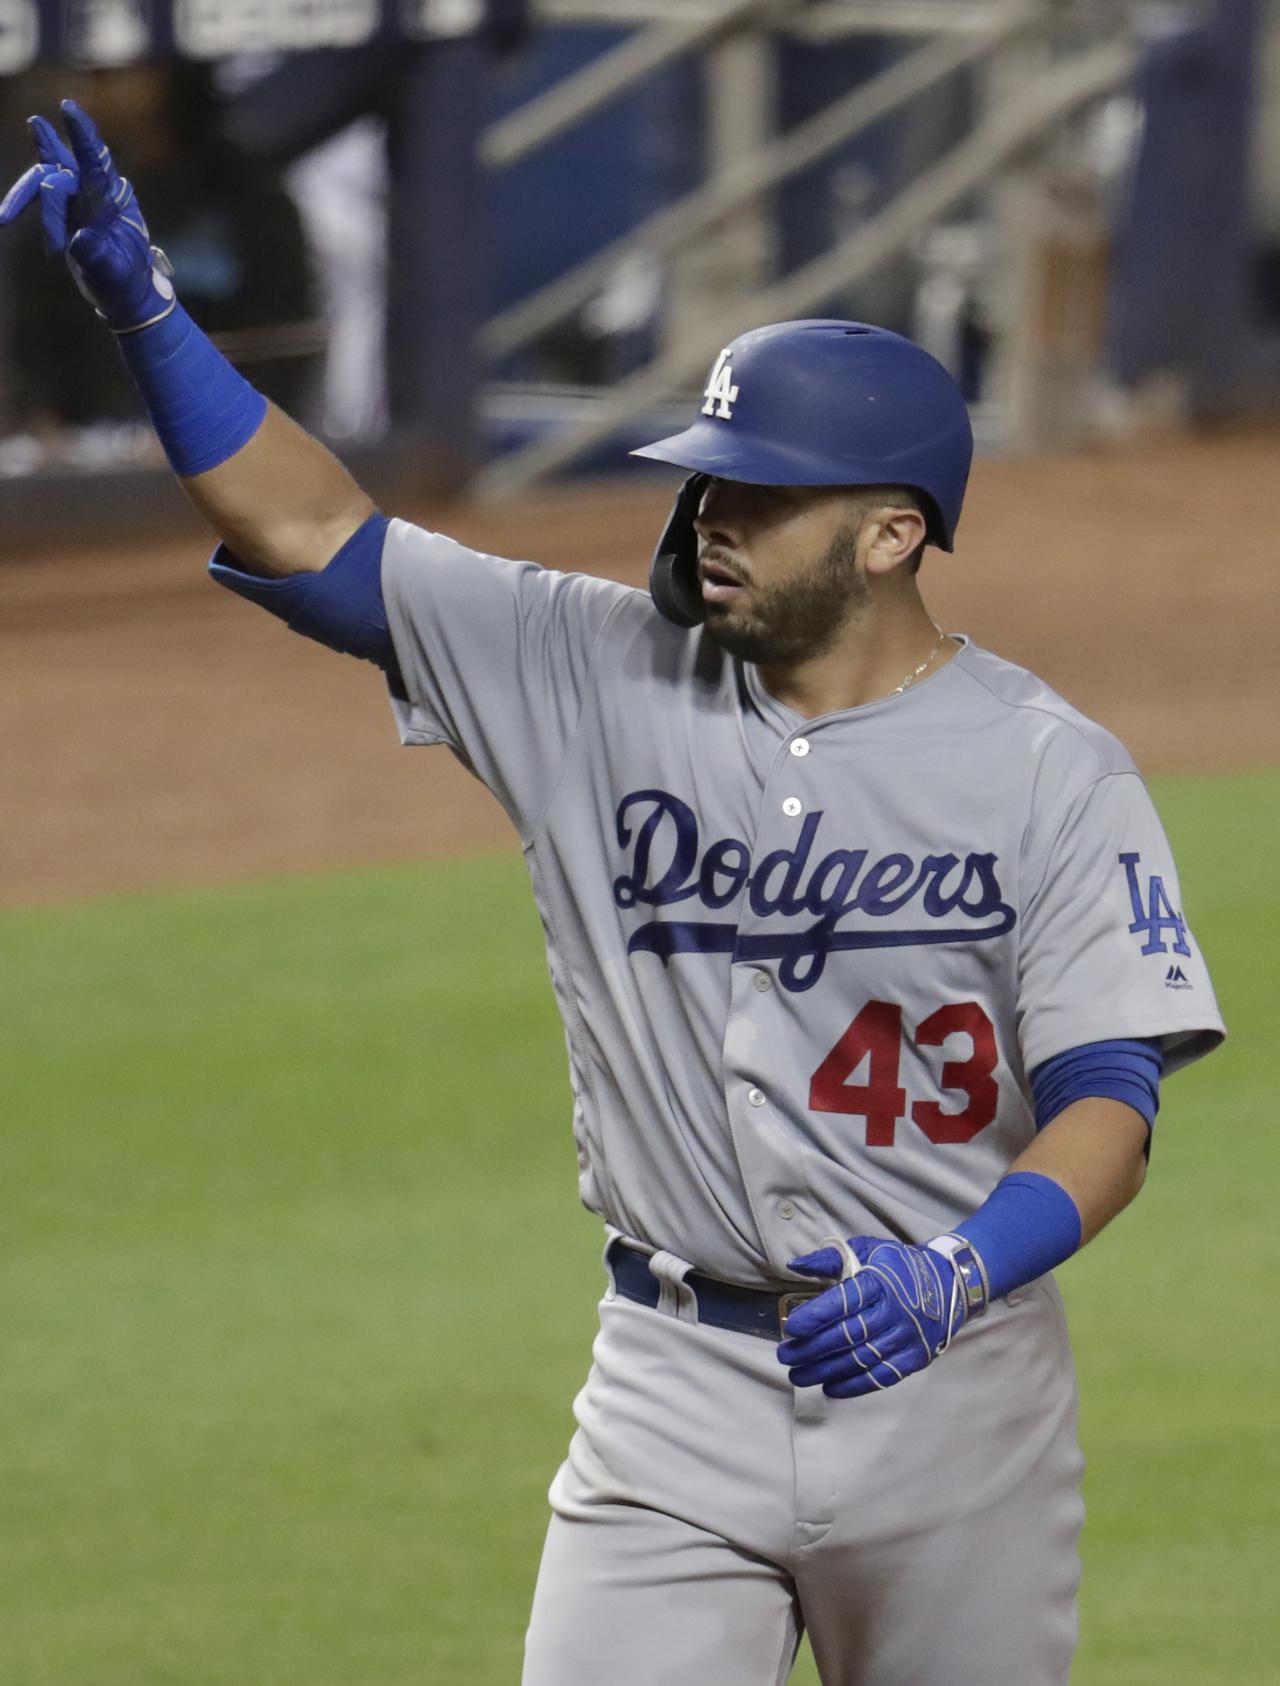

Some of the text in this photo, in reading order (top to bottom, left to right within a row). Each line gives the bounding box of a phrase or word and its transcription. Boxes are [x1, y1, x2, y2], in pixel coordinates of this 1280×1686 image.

[701, 348, 740, 420] LA
[613, 789, 1017, 993] Dodgers
[1118, 852, 1191, 958] LA
[808, 999, 1000, 1147] 43
